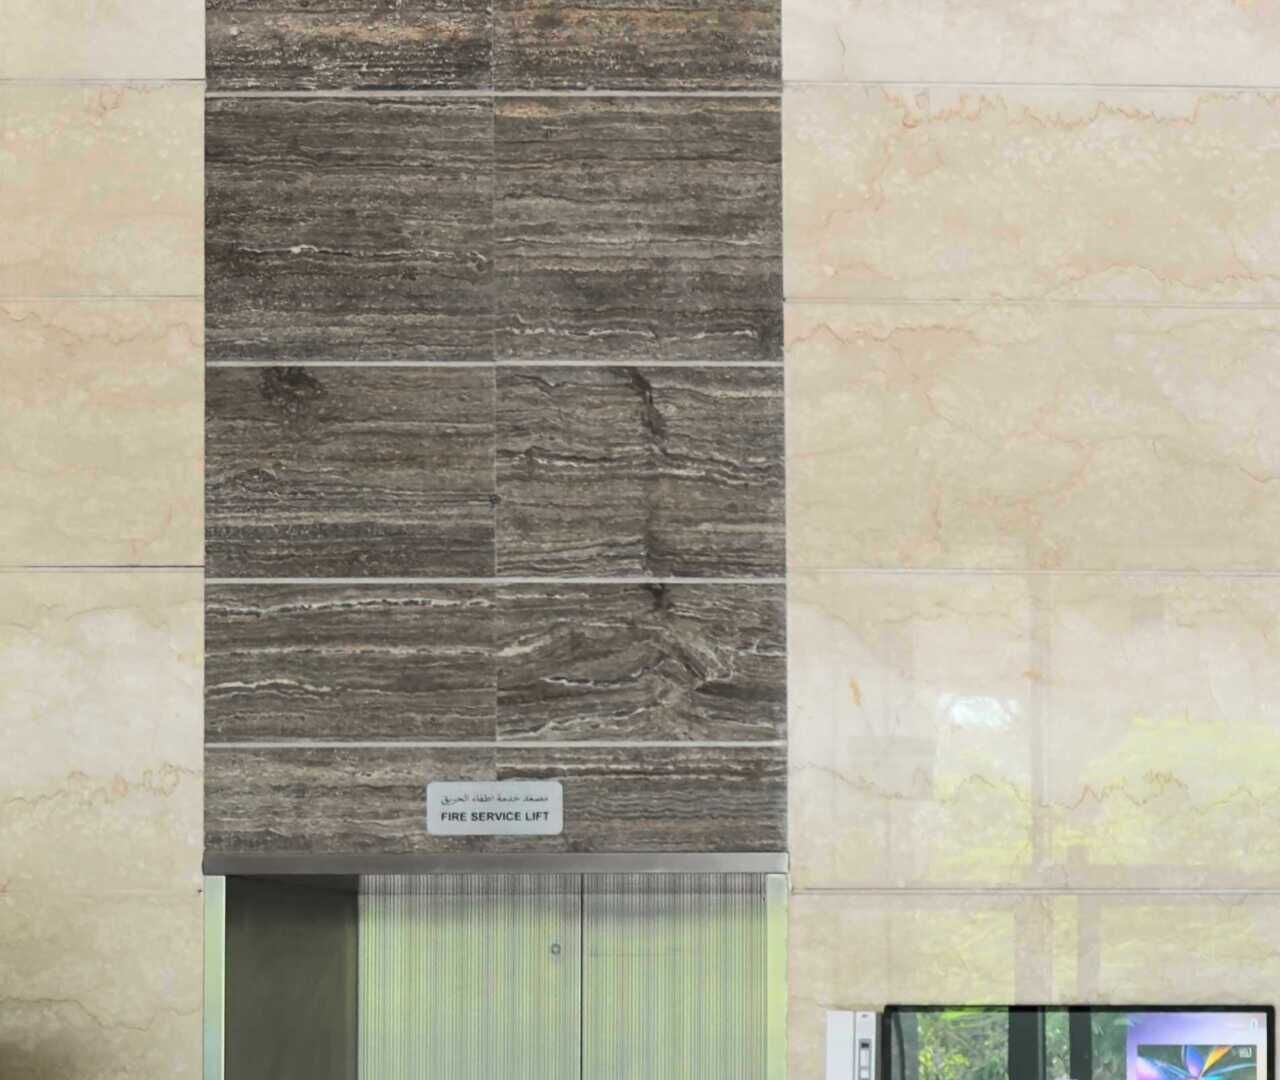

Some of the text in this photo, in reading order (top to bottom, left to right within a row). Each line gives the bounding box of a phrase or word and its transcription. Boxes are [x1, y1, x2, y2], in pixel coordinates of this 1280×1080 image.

[441, 811, 549, 822] FIRE SERVICE LIFT
